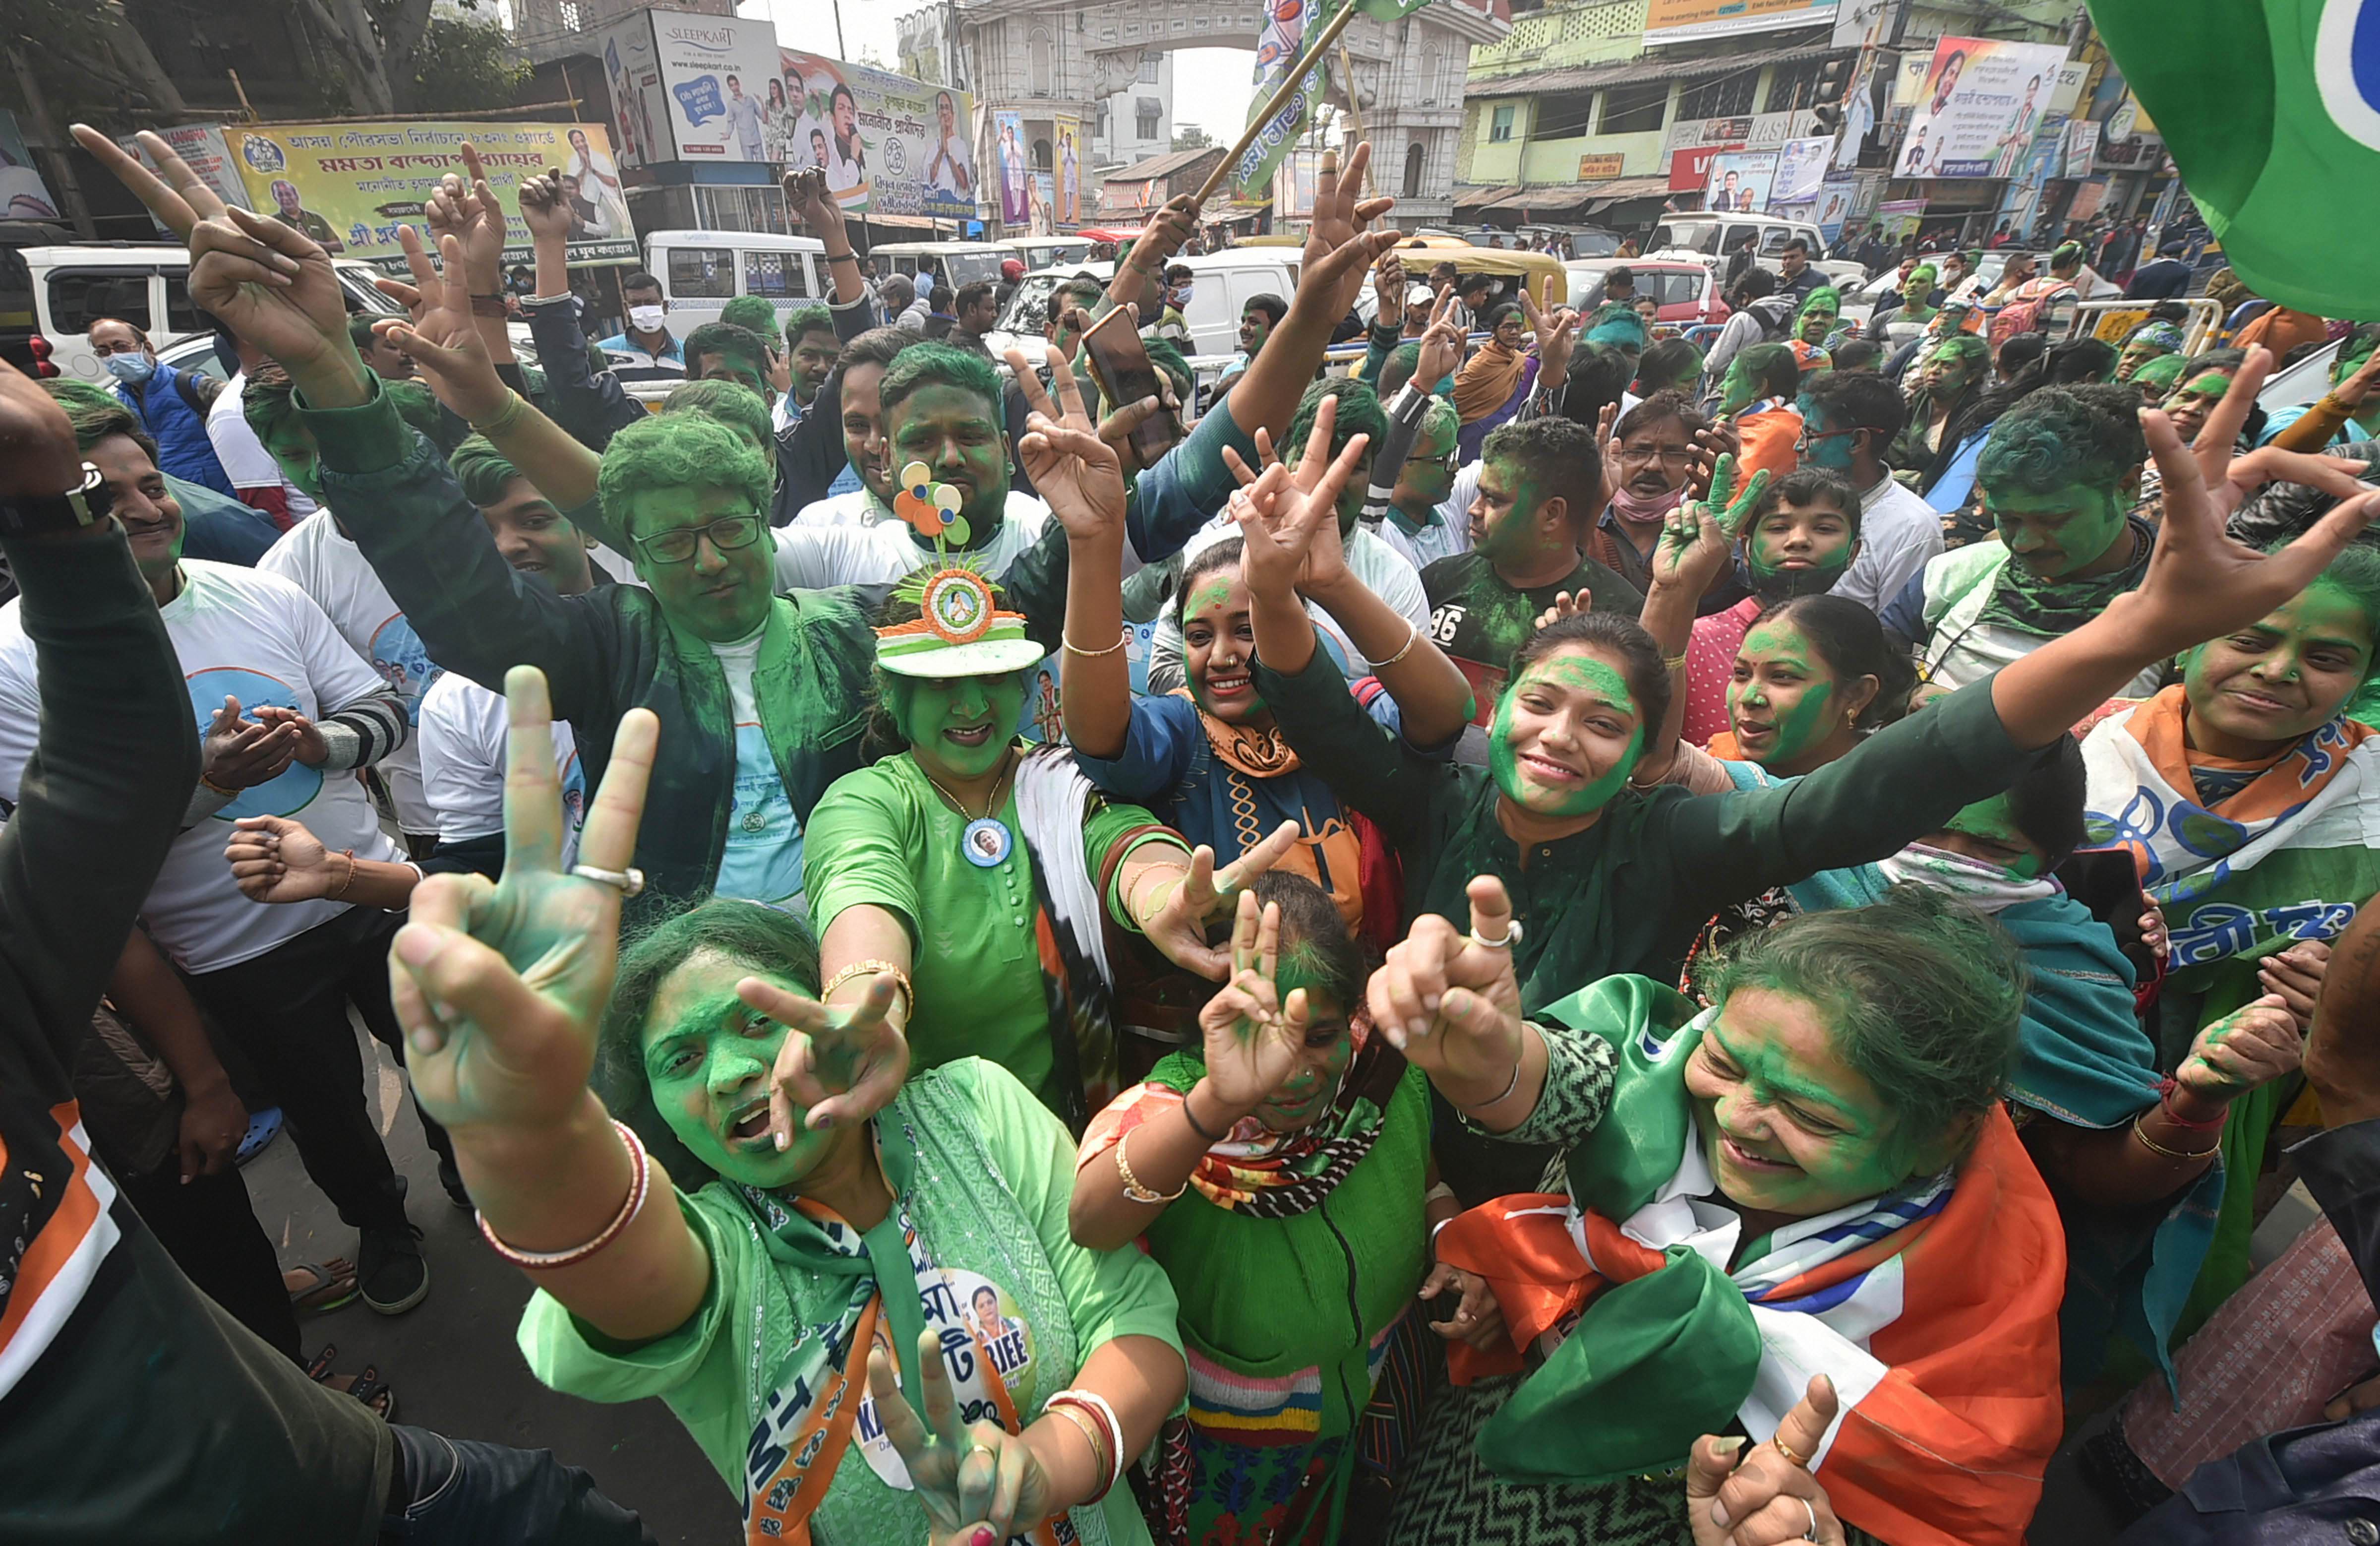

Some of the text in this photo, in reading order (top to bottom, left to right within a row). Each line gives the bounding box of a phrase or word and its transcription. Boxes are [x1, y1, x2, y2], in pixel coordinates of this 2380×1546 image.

[666, 27, 737, 46] SLEEPKART
[671, 60, 741, 72] www.sleepkart.co.in
[857, 109, 926, 140] মনোনীত প্রার্থীদের
[287, 135, 332, 149] আসন্ন
[339, 131, 405, 148] পৌরসভা
[407, 128, 467, 146] নির্বাচনে
[317, 152, 543, 172] মমতা বন্দ্যোপধ্যায়ের
[356, 176, 405, 192] মনোনীত
[349, 222, 375, 247] শ্রী
[578, 245, 596, 259] যুব
[596, 244, 633, 256] কংগ্রেস
